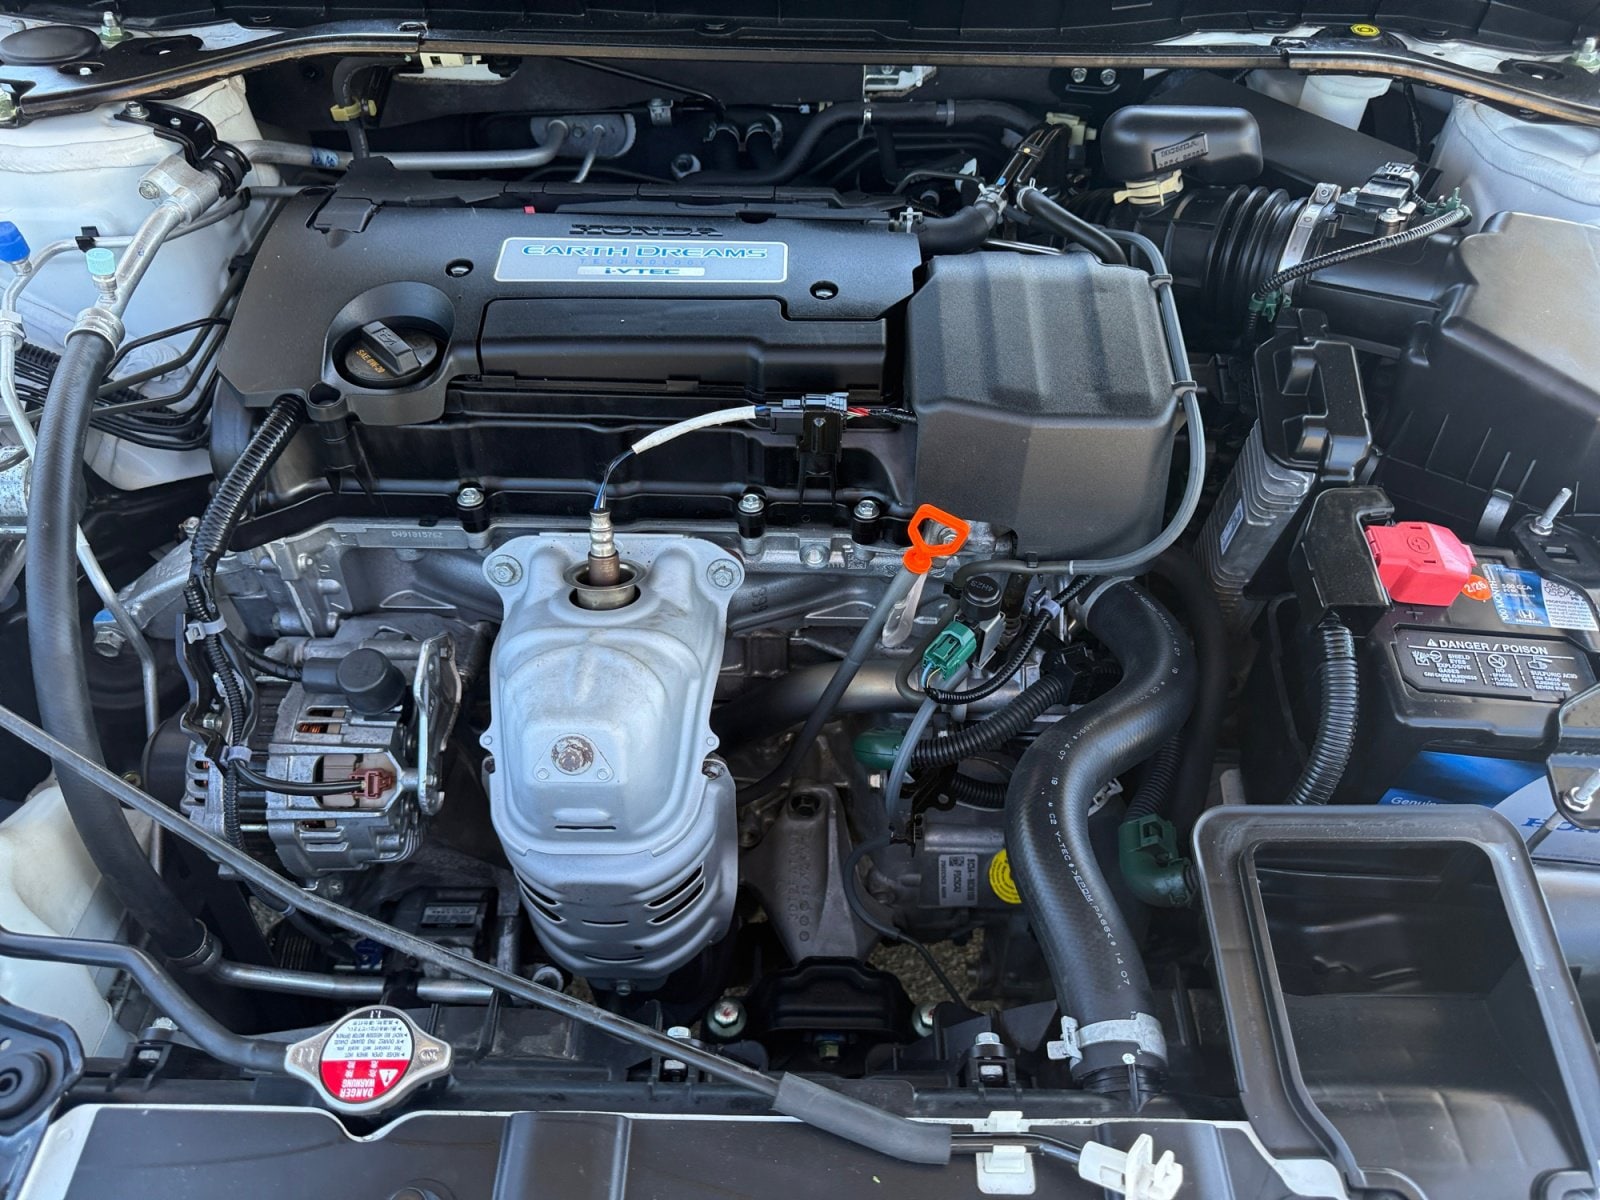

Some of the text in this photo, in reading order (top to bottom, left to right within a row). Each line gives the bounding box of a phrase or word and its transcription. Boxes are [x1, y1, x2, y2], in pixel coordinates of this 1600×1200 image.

[569, 223, 723, 237] HONDA
[523, 244, 768, 259] EARTH DREAMS
[579, 258, 707, 266] TECHNOLOGY
[1438, 639, 1490, 651] DANGER
[1501, 644, 1549, 656] POISON
[1436, 662, 1472, 671] EXPLOSIVE
[1530, 670, 1562, 678] SULFURIC
[1058, 750, 1066, 761] 07
[1054, 830, 1072, 861] Y-TEC
[1120, 970, 1130, 986] 07
[369, 1010, 382, 1018] 1.1
[340, 1088, 374, 1098] DANGER
